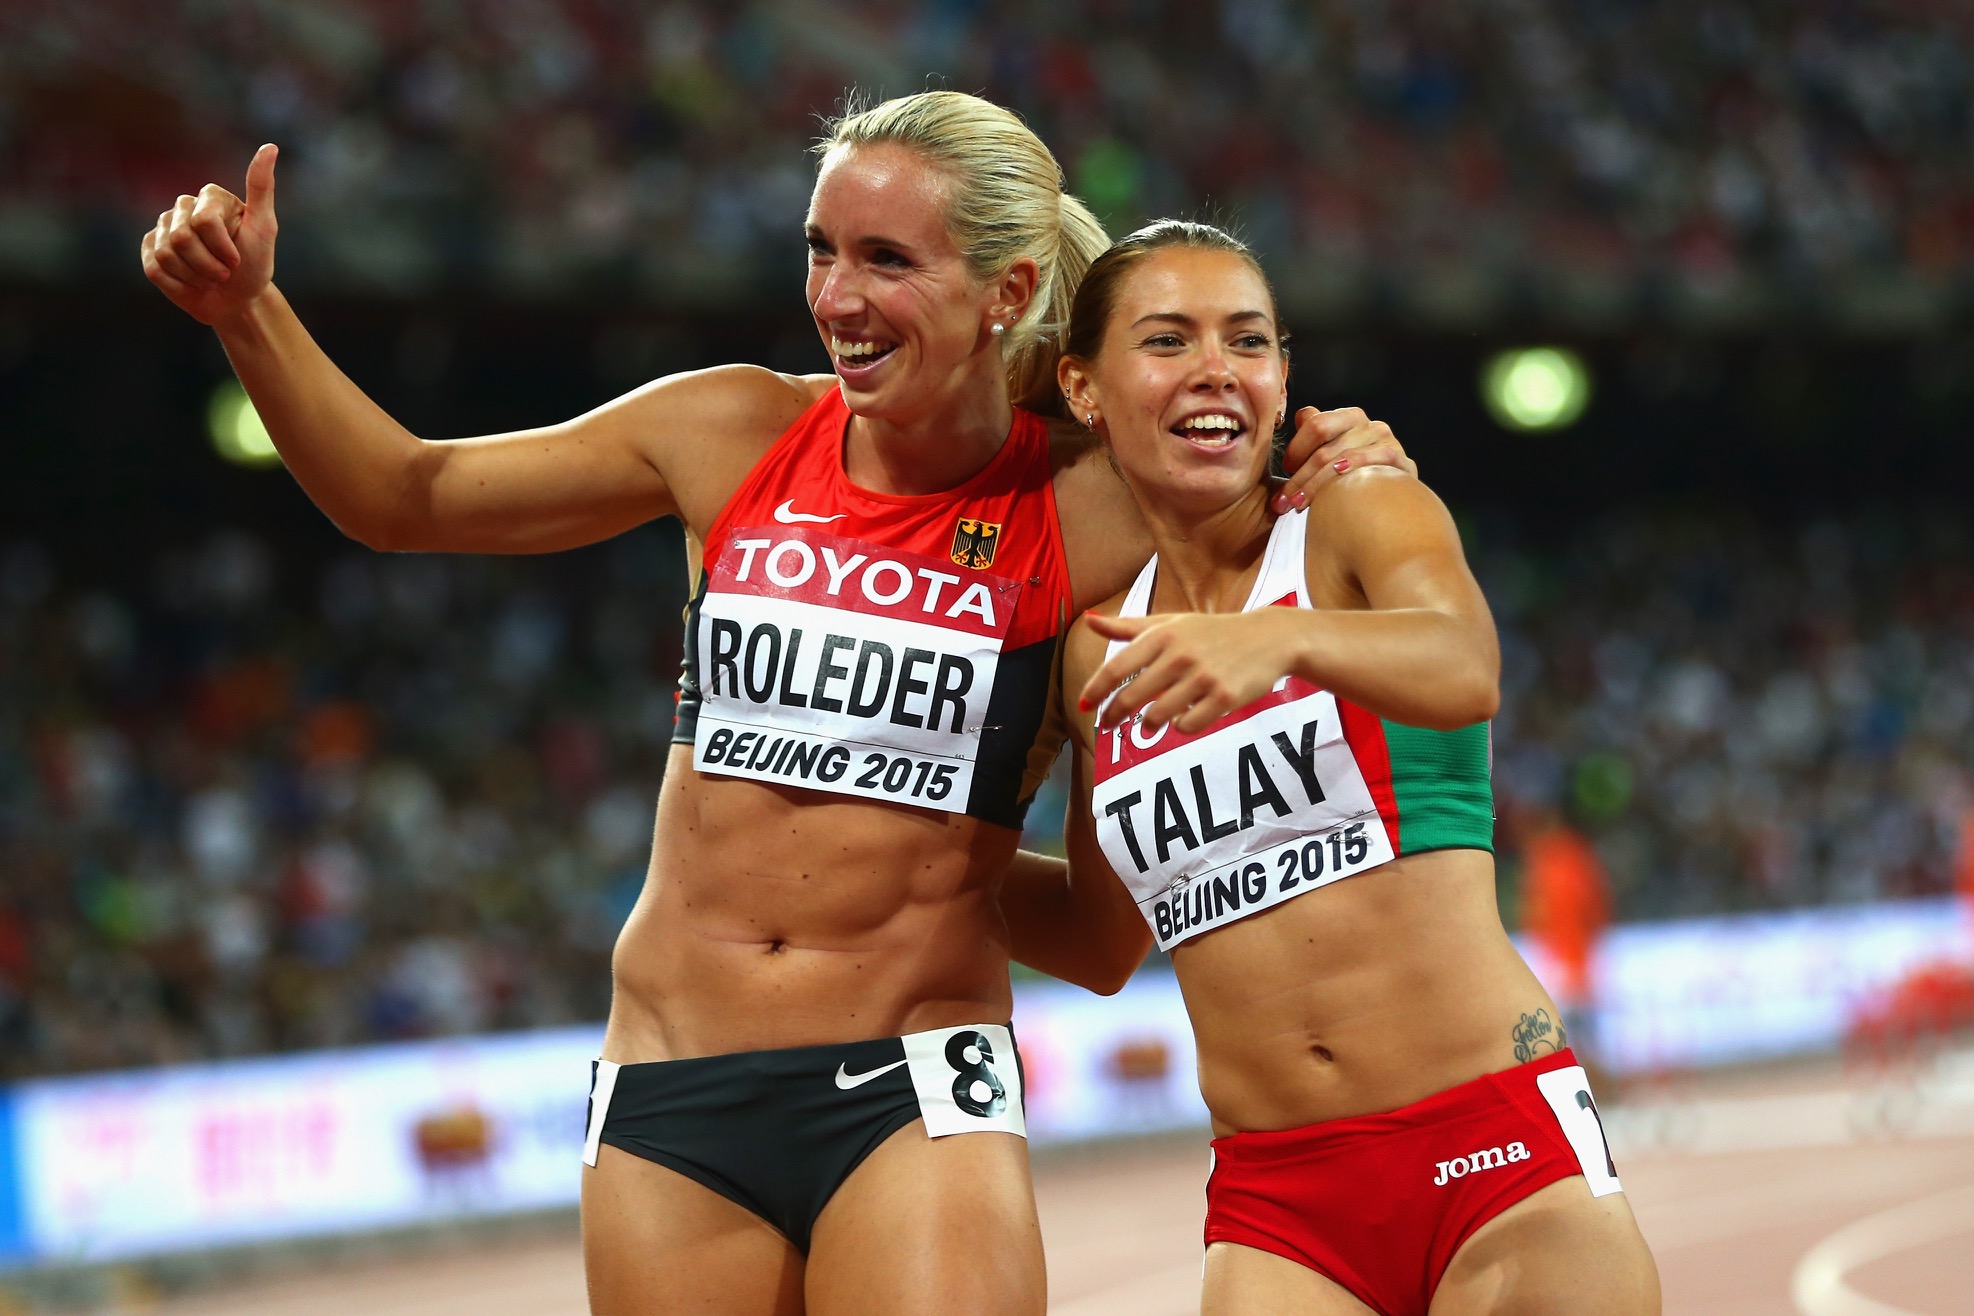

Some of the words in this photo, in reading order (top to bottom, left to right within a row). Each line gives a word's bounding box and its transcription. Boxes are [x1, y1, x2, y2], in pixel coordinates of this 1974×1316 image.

[734, 538, 997, 627] TOYOTA
[710, 617, 975, 735] ROLEDER
[702, 728, 851, 783] BEIJING
[854, 753, 960, 801] 2015
[1104, 719, 1327, 875] TALAY
[1153, 866, 1267, 943] BEIJING
[1276, 821, 1369, 893] 2015
[944, 1029, 1008, 1118] 8
